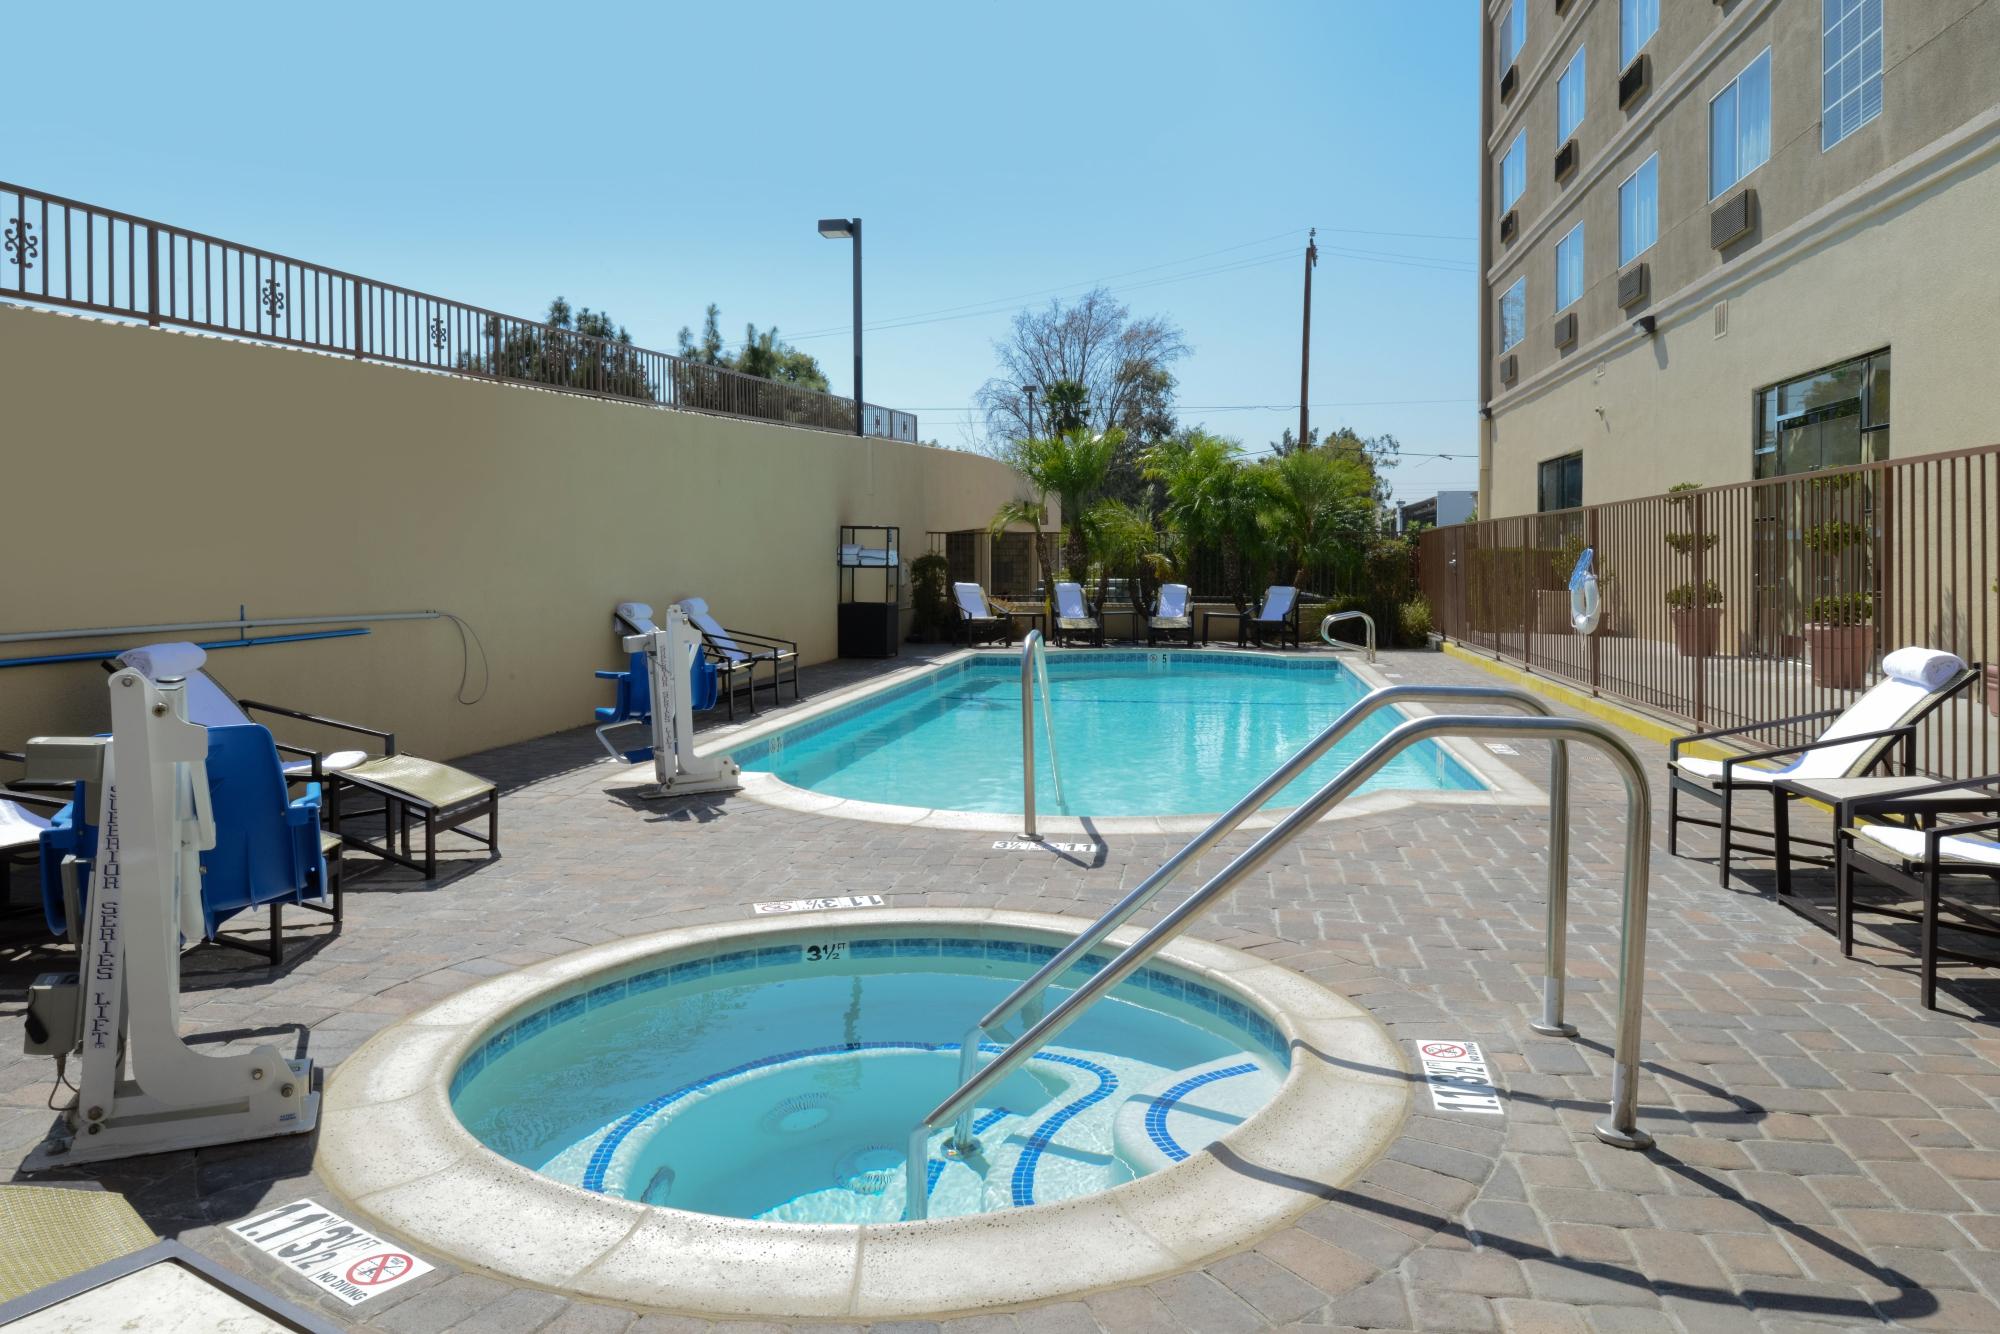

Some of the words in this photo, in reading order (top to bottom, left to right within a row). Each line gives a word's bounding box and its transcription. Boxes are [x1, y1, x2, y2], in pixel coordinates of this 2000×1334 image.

[97, 901, 118, 980] SERIES
[837, 942, 847, 950] FT
[92, 992, 111, 1046] LIFT
[320, 1217, 340, 1226] M
[359, 1239, 382, 1250] FT
[317, 1271, 336, 1283] NO
[329, 1278, 368, 1301] DIVING
